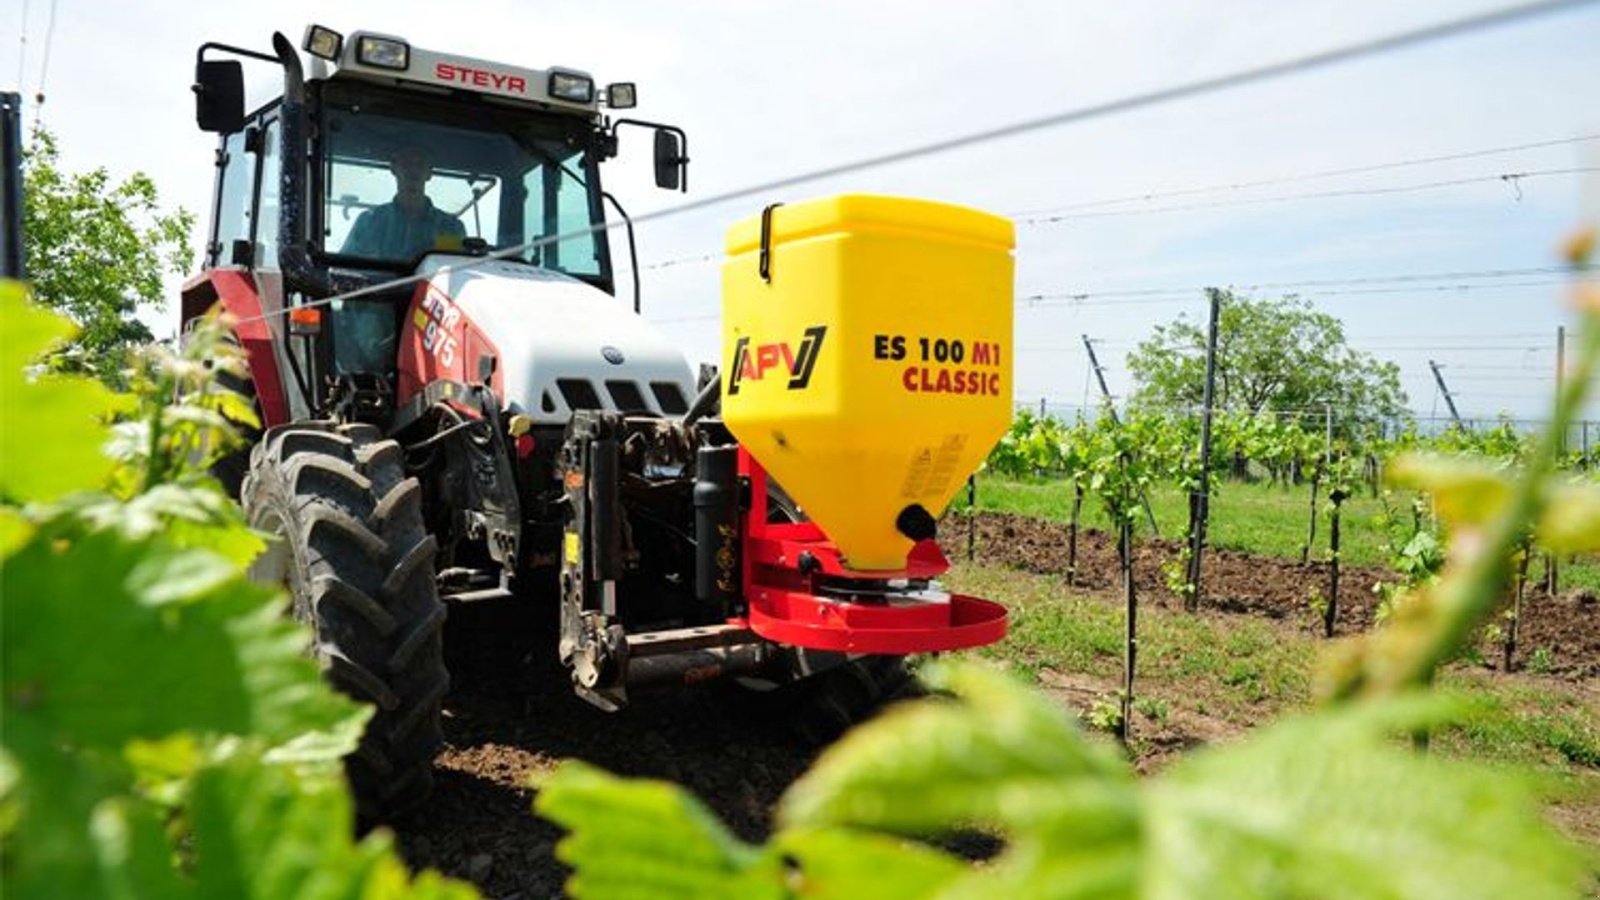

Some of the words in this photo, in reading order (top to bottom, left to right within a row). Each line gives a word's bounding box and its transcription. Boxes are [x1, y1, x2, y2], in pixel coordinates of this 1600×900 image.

[436, 63, 526, 93] STEYR
[422, 286, 461, 333] STEYR
[423, 320, 458, 368] 975
[874, 334, 906, 361] ES
[919, 337, 964, 364] 100
[971, 341, 1000, 366] M1
[902, 365, 1000, 397] CLASSIC
